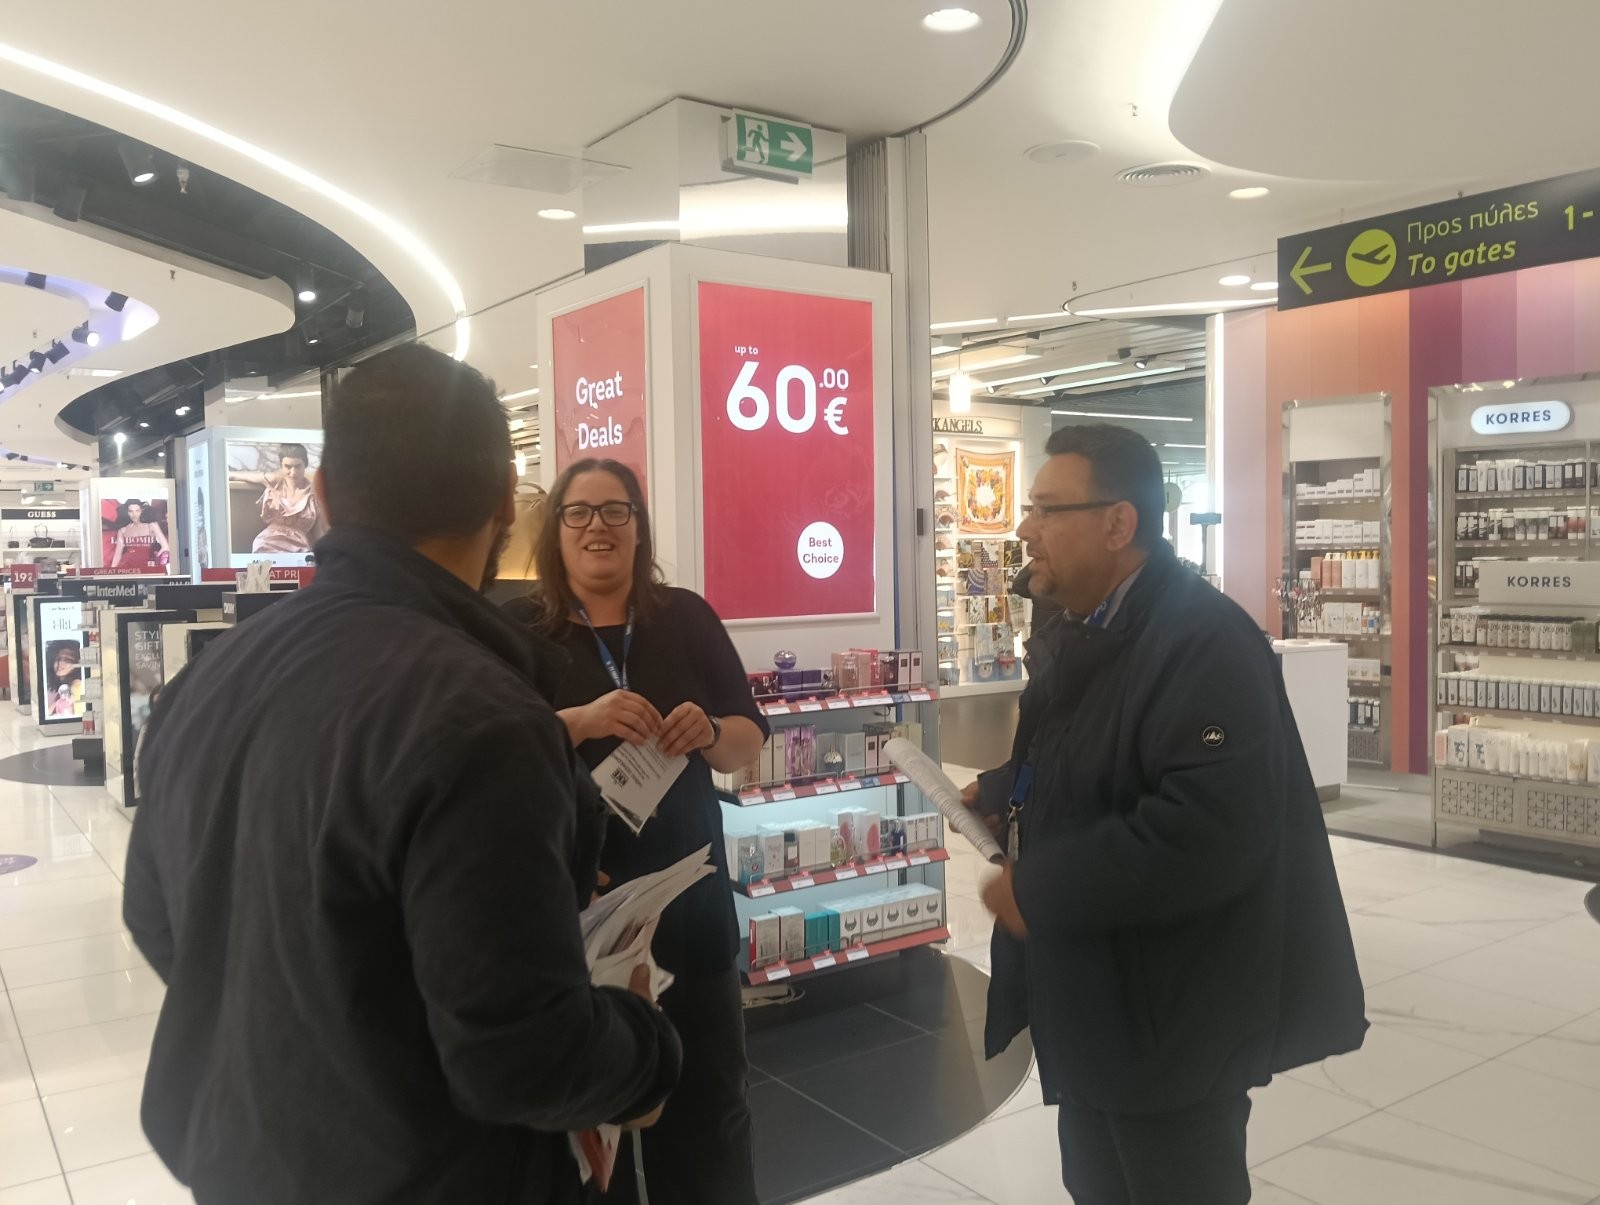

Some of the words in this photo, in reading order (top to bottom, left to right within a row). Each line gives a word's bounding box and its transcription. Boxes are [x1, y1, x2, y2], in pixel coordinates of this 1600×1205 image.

[1407, 217, 1462, 244] Προς
[1470, 200, 1539, 230] πύλες
[1408, 253, 1436, 277] To
[1446, 240, 1516, 276] gates
[734, 345, 747, 356] up
[749, 345, 759, 355] to
[575, 370, 623, 408] Great
[1486, 409, 1551, 425] KORRES
[578, 415, 623, 450] Deals
[809, 537, 832, 548] Best
[803, 553, 839, 564] Choice
[1507, 576, 1571, 588] KORRES
[96, 585, 135, 597] InterMed
